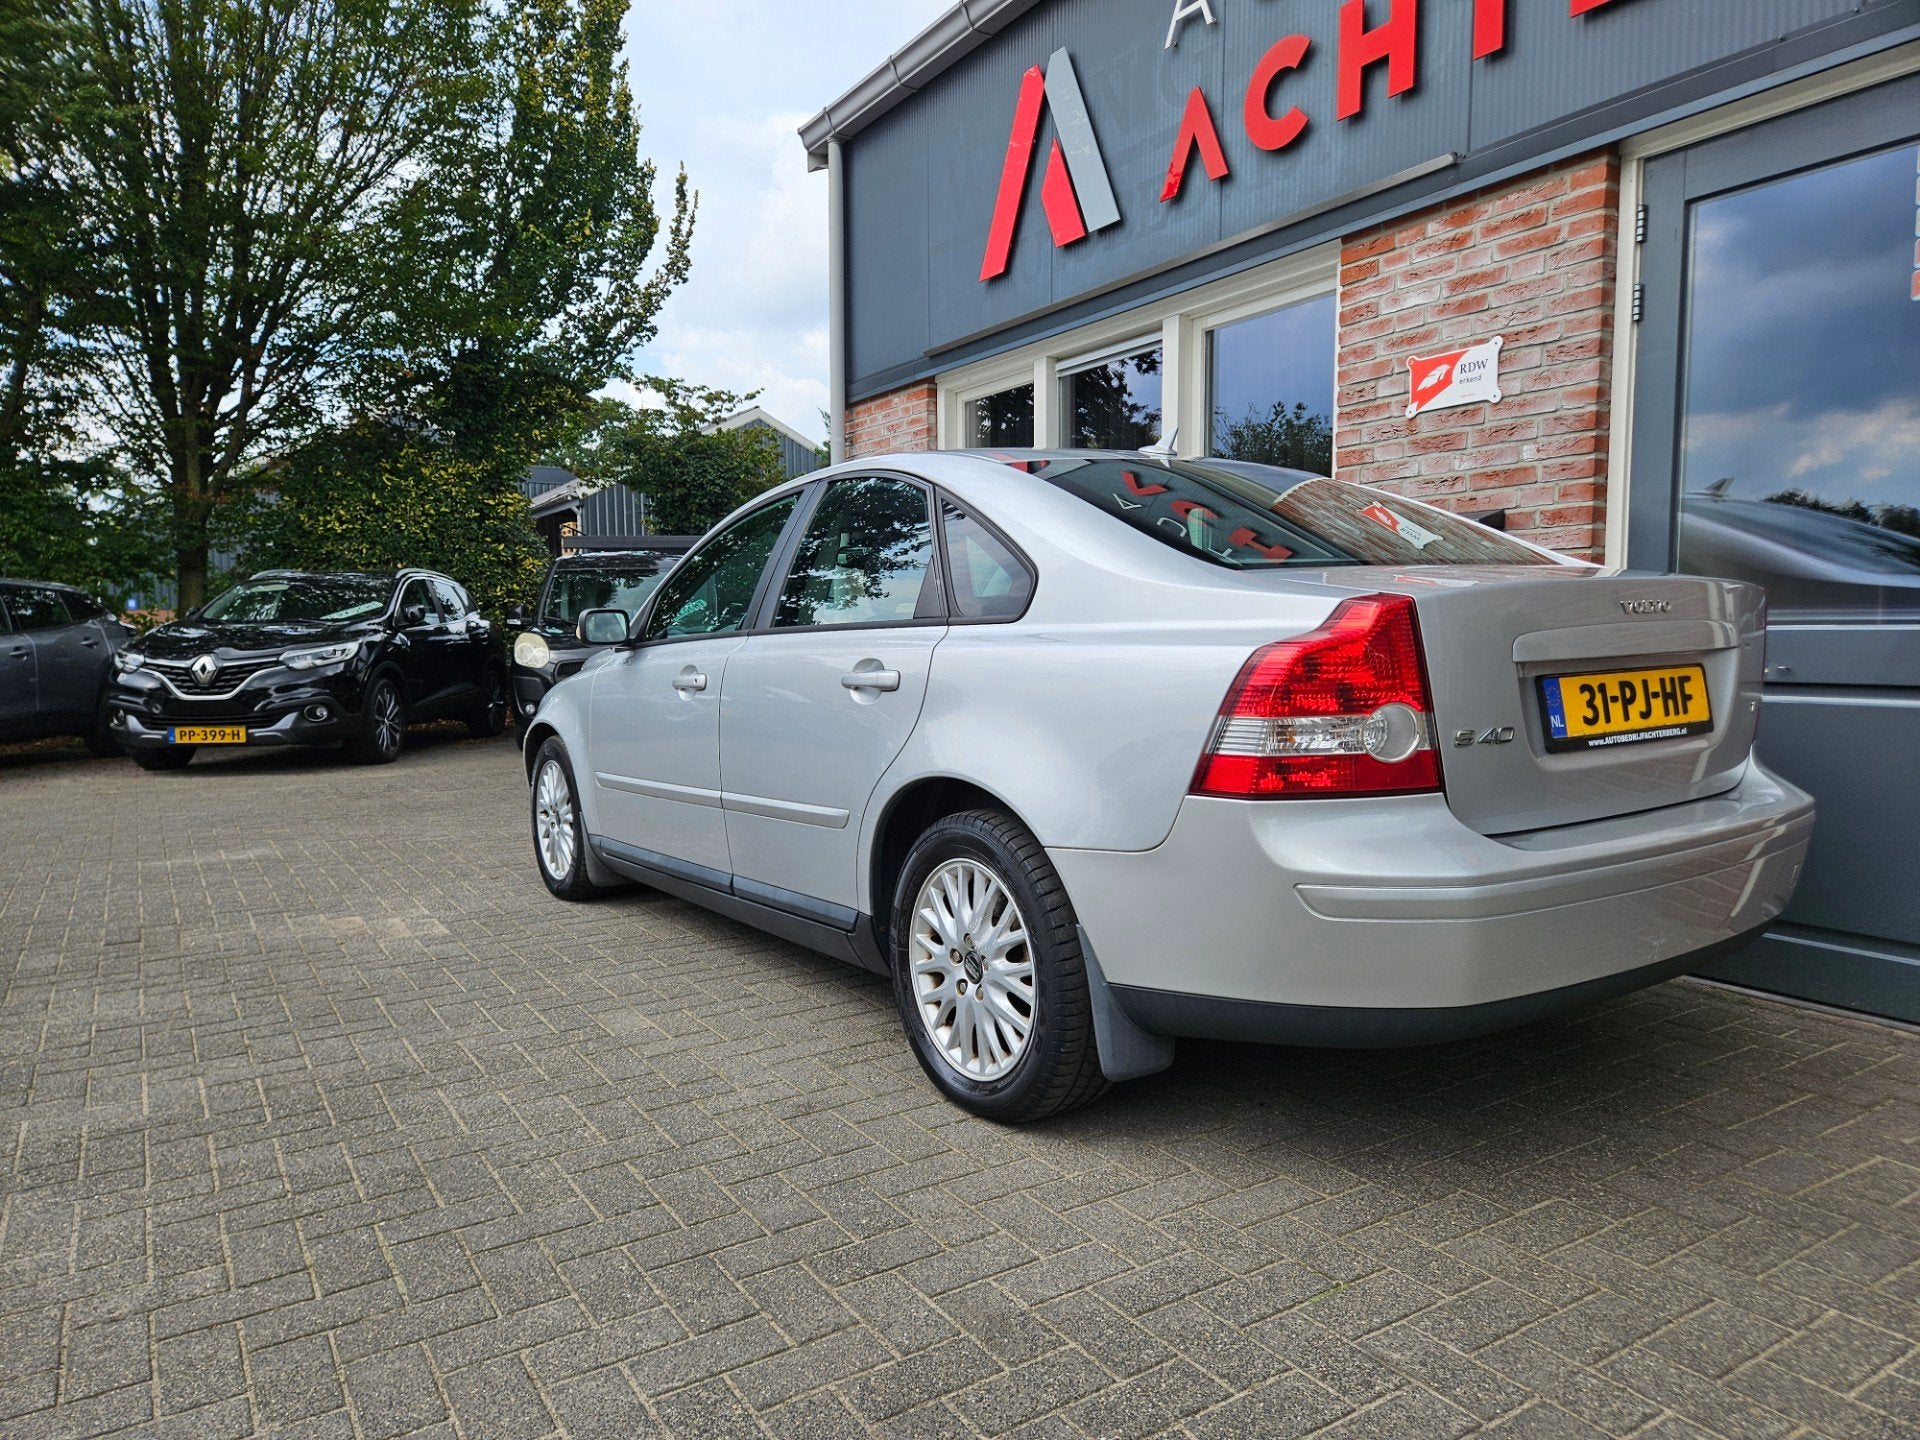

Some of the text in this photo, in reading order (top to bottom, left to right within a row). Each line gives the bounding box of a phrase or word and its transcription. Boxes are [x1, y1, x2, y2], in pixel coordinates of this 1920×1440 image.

[1160, 0, 1612, 202] ACH
[1460, 358, 1488, 374] RDW
[1459, 374, 1482, 385] erkend
[1619, 599, 1672, 615] VOLVO
[1578, 675, 1693, 727] 31-PJ-HF
[1550, 714, 1564, 728] NL
[179, 729, 240, 741] PP-399-H
